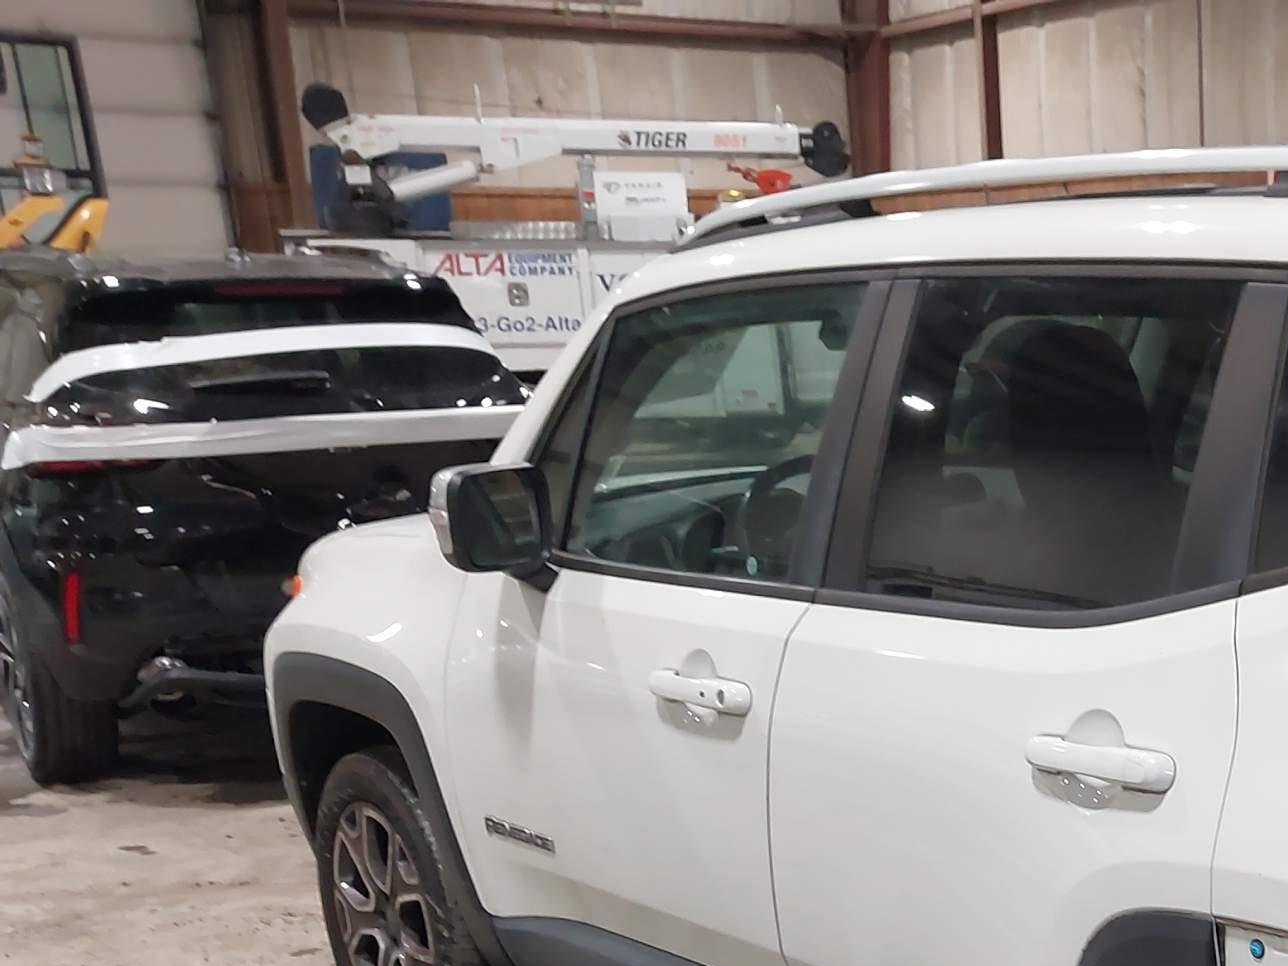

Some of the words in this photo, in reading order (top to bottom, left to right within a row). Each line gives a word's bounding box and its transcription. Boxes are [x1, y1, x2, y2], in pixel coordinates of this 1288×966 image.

[635, 131, 688, 148] TIGER
[433, 252, 507, 276] ALTA
[507, 252, 574, 264] EQUIPMENT
[509, 265, 575, 276] COMPANY
